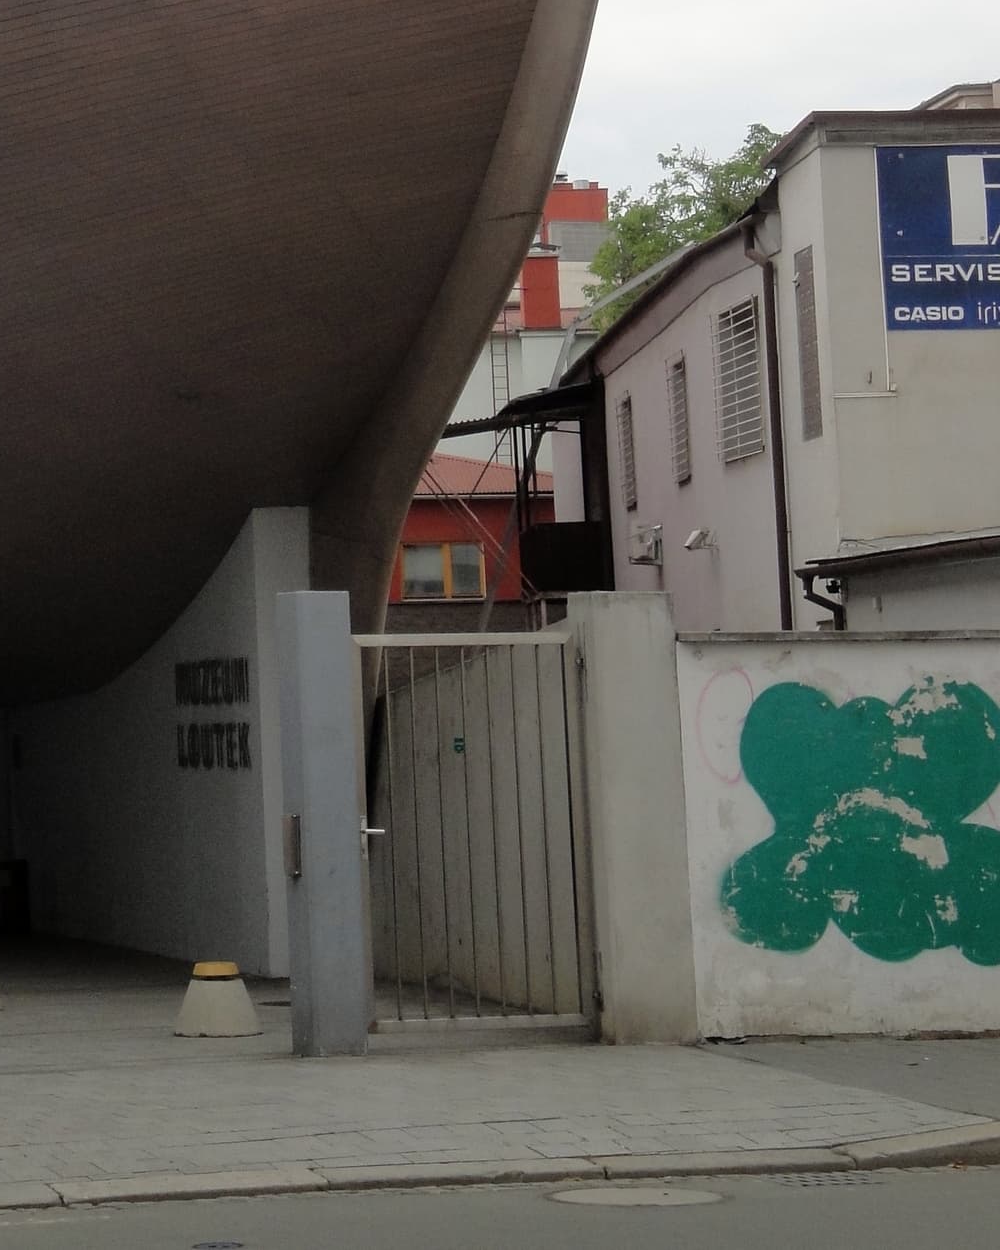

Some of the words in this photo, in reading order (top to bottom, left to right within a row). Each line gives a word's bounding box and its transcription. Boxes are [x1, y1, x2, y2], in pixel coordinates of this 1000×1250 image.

[894, 306, 965, 322] CASIO
[977, 301, 1000, 325] iri
[177, 722, 252, 770] LOUTEK
